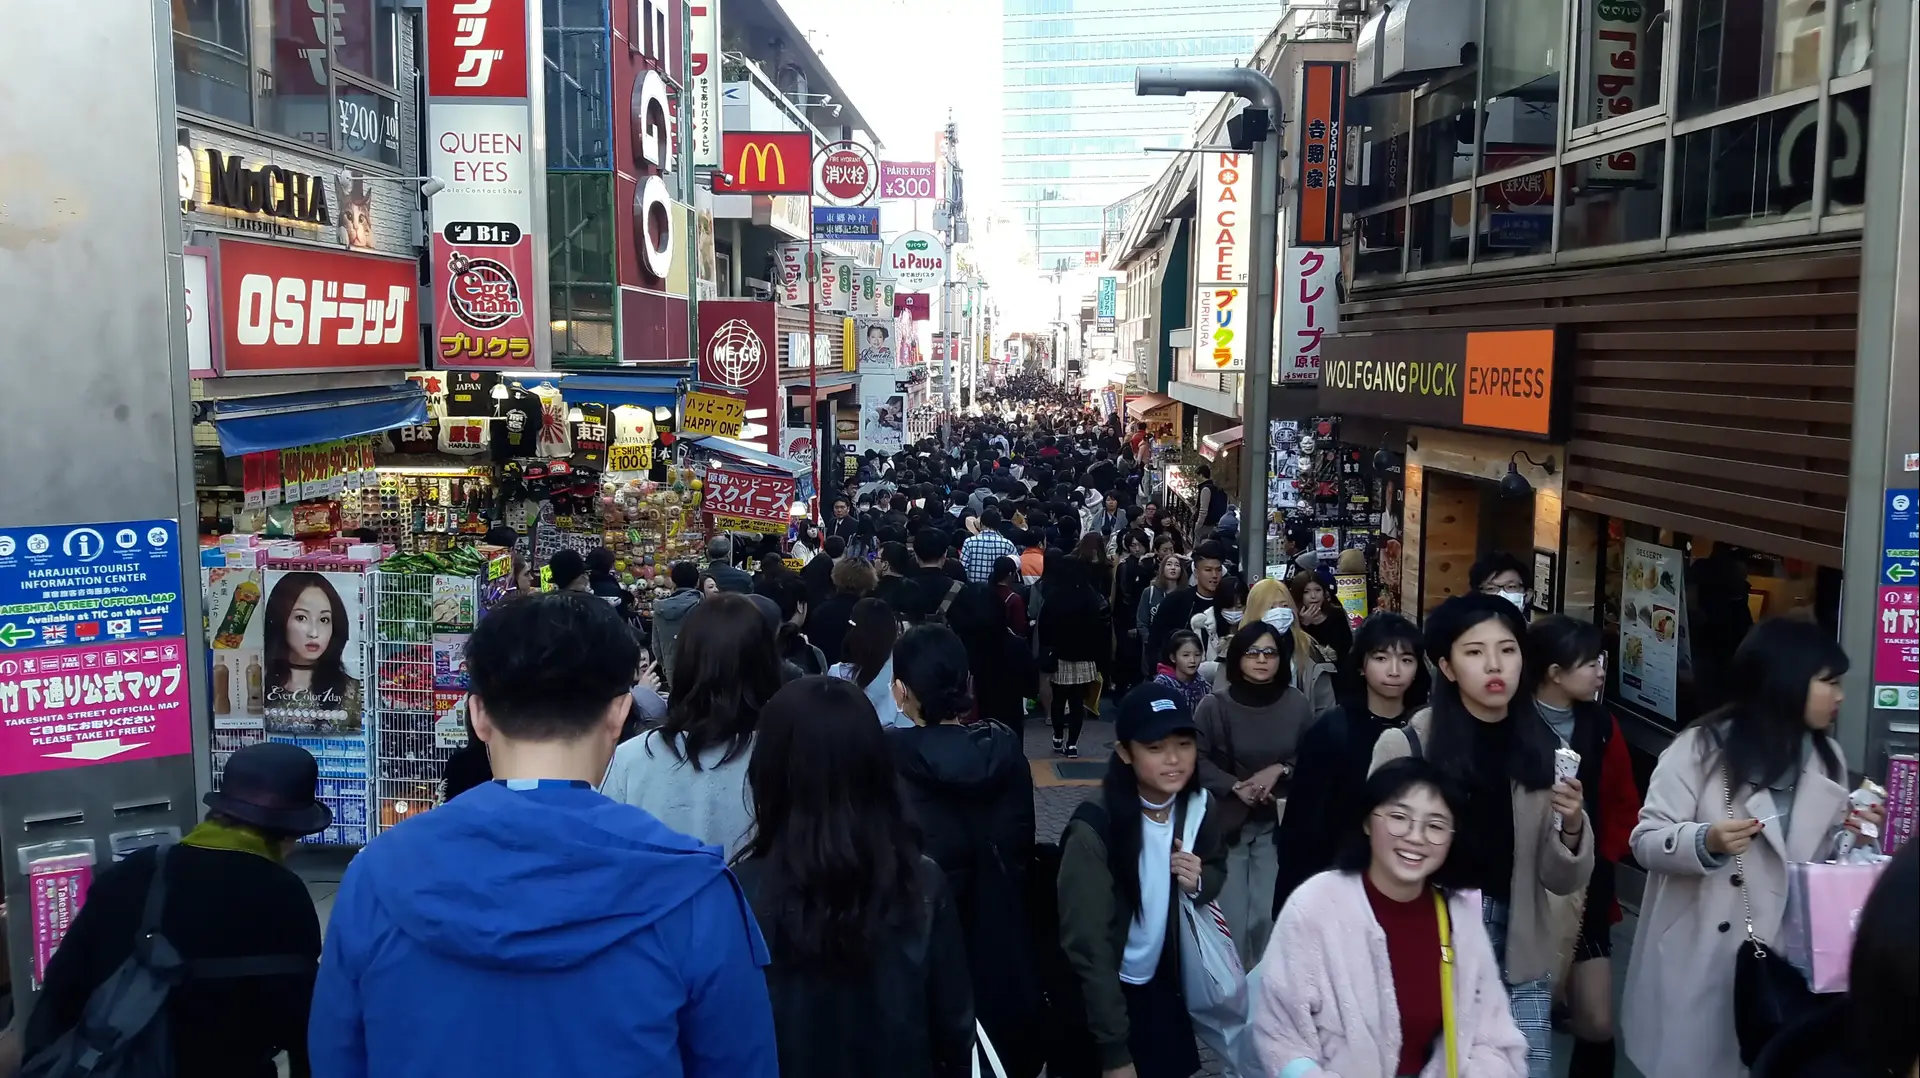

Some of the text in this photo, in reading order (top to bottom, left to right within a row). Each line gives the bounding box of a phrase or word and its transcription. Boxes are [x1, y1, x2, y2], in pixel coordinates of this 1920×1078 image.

[440, 132, 522, 154] QUEEN
[454, 162, 508, 182] EYES
[826, 166, 865, 185] 消火栓
[886, 167, 931, 176] PARIS KID'S
[886, 177, 931, 196] ¥300
[1215, 210, 1237, 281] CAFE
[908, 253, 942, 270] Pausa
[1238, 273, 1248, 281] 1F
[237, 273, 410, 346] OSドラッグ
[1297, 250, 1325, 354] クレープ
[1200, 291, 1210, 348] PURIKURA
[1212, 288, 1238, 368] プリクラ
[1233, 358, 1244, 366] B1
[455, 383, 482, 391] JAPAN
[1469, 366, 1545, 399] EXPRESS
[686, 398, 744, 418] ハッピーワン
[683, 414, 741, 437] HAPPY ONE
[620, 436, 646, 444] JAPAN
[611, 445, 647, 456] T-SHIRT
[610, 454, 649, 469] ¥1000
[707, 472, 793, 492] 原宿ハッピーワン
[706, 483, 793, 512] スクイーズ
[705, 501, 790, 519] SQUEEZE
[28, 563, 140, 578] HARAJUKU TOURIST
[21, 572, 147, 590] INFORMATION CENTER
[0, 592, 176, 615] AKESHITA STREET OFFICIAL MAP
[27, 605, 169, 625] Available at TIC on the Left!
[1882, 608, 1919, 634] 竹下
[0, 663, 182, 714] 竹下通り公式マップ
[5, 701, 180, 727] TAKESHITA STREET OFFICIAL MAP
[29, 715, 156, 736] ご自由にお取りください
[33, 725, 156, 746] PLEASE TAKE IT FREELY
[1905, 771, 1917, 806] Takeshita
[1901, 818, 1911, 834] MAP
[58, 886, 69, 930] Takeshita
